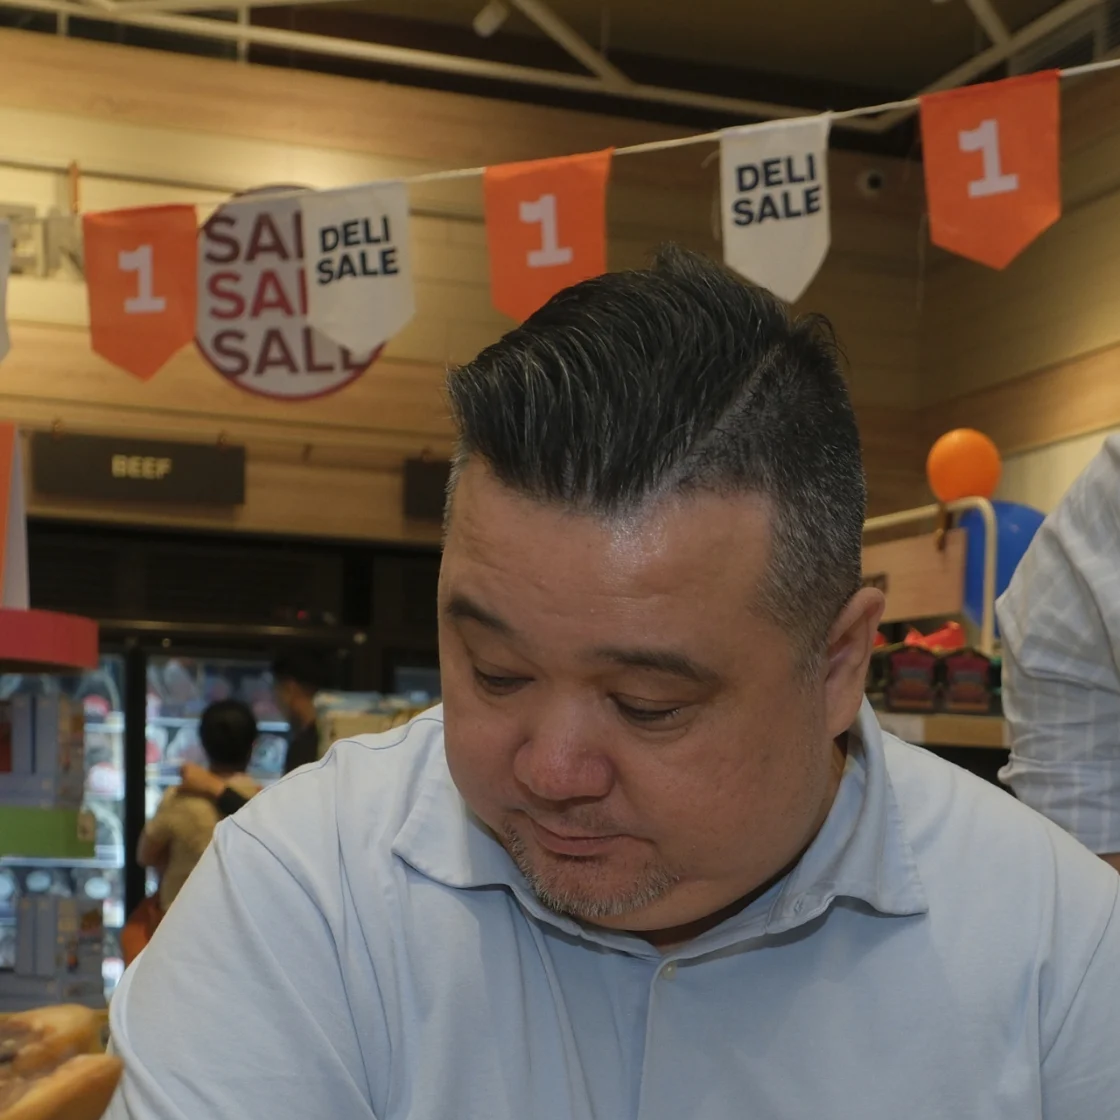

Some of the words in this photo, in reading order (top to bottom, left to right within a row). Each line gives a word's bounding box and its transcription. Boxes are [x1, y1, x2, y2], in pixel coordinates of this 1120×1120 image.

[736, 152, 816, 193] DELI
[958, 118, 1019, 199] 1
[732, 185, 822, 227] SALE
[319, 215, 391, 253] DELI
[519, 194, 574, 268] 1
[117, 244, 167, 314] 1
[317, 248, 399, 286] SALE
[111, 453, 172, 480] BEEF
